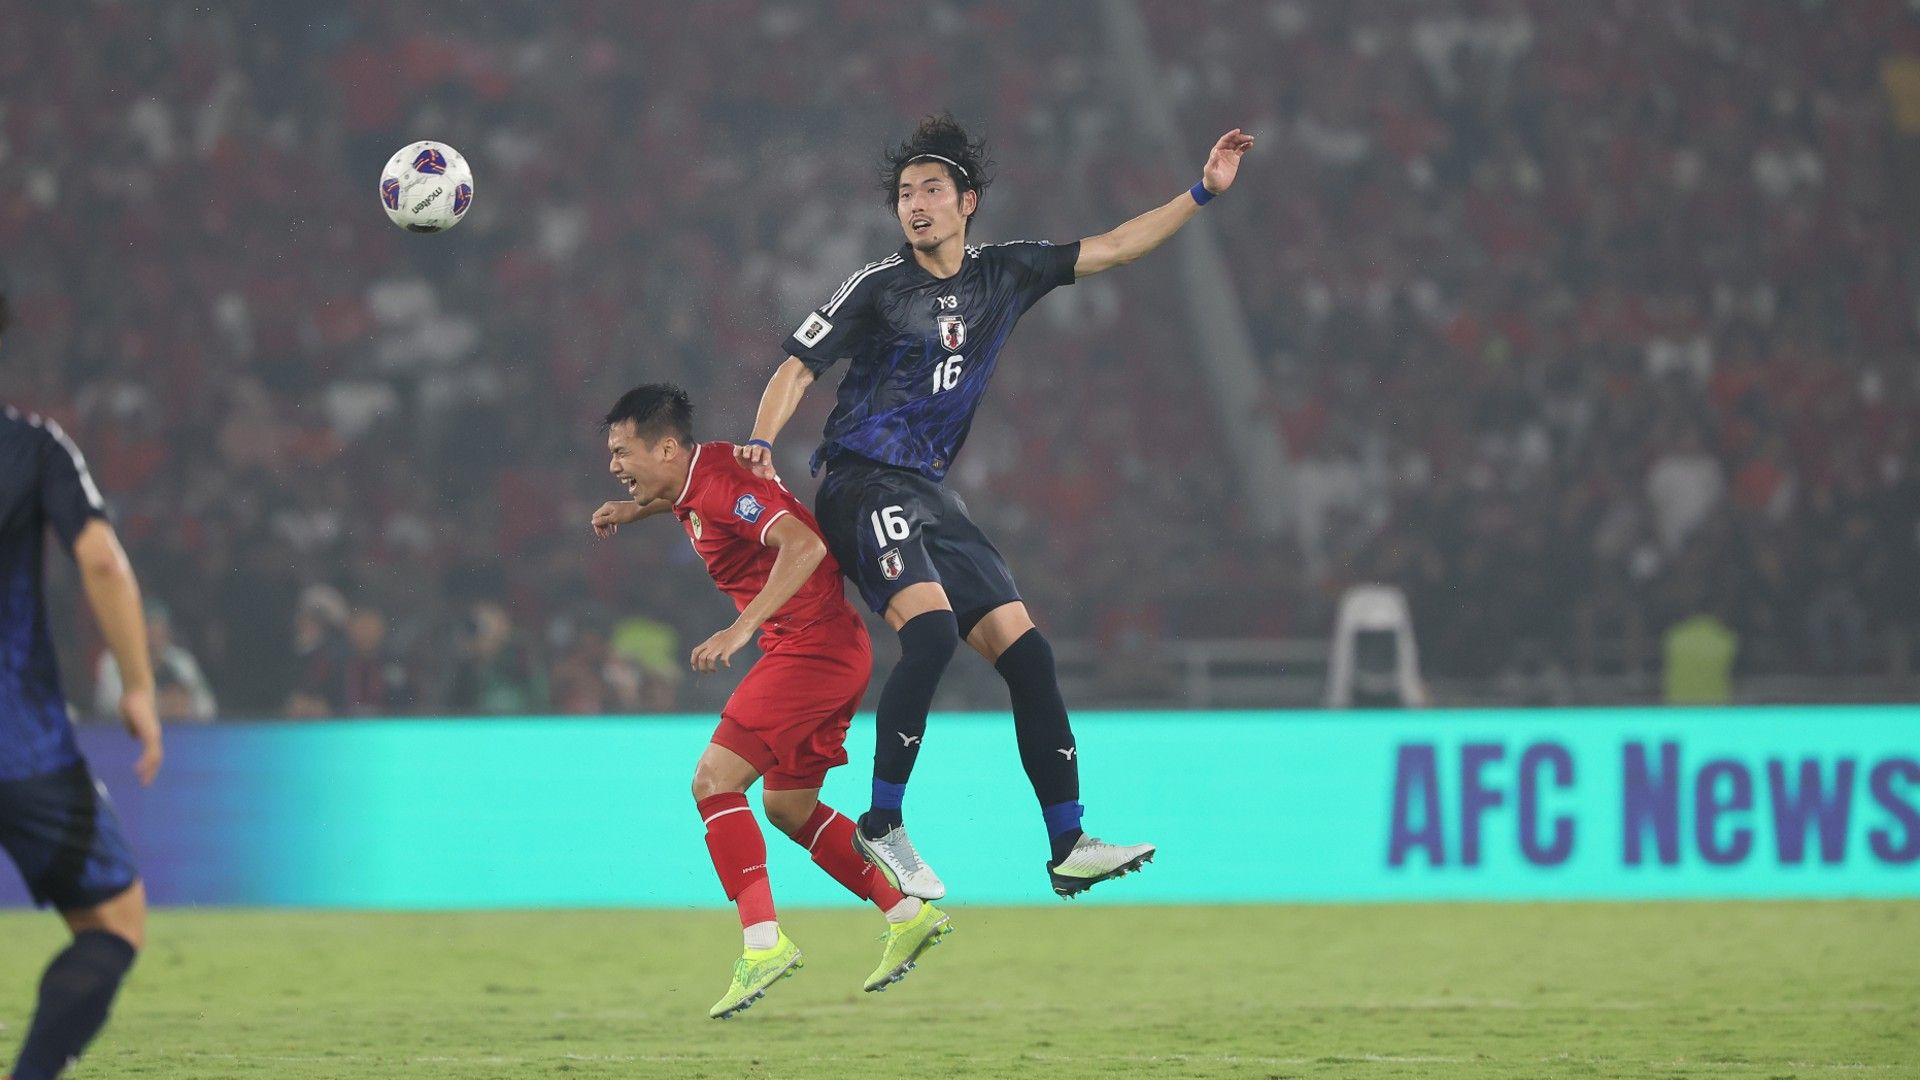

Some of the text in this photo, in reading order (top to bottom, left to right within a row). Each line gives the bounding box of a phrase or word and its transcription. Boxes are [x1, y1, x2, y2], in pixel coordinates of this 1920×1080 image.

[411, 186, 443, 214] molten
[932, 354, 964, 395] 16
[870, 505, 910, 549] 16
[1387, 741, 1920, 867] AFC News
